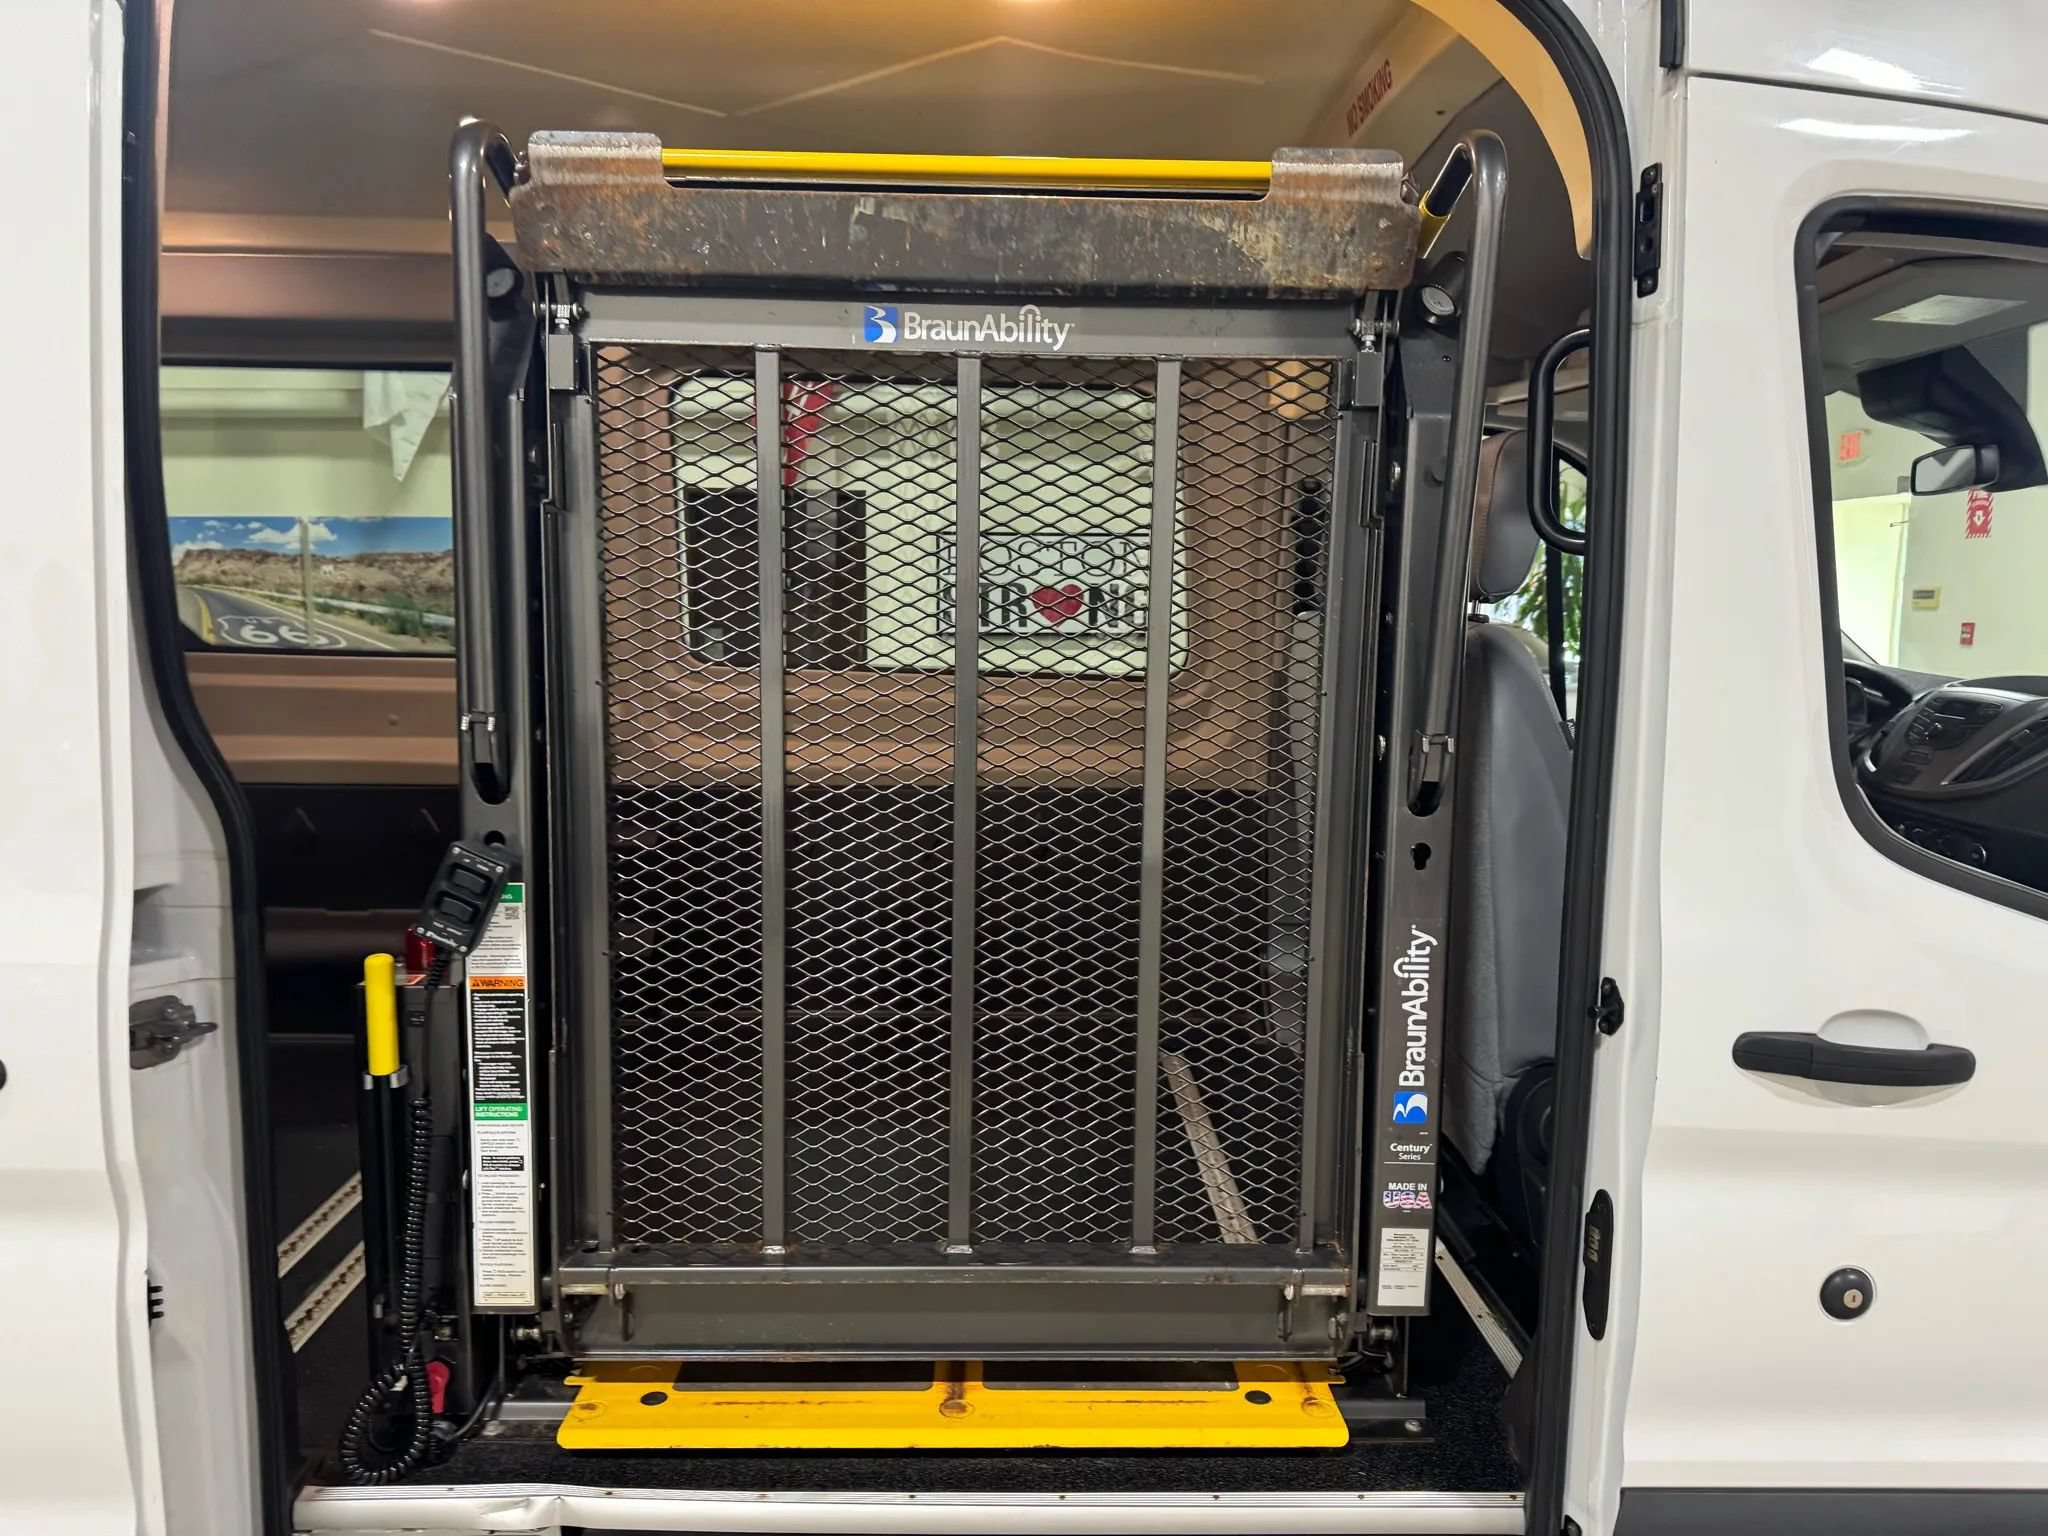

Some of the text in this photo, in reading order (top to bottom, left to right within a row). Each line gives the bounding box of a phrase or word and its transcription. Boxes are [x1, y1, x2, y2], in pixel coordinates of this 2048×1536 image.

[903, 304, 1070, 351] BraunAbility
[480, 978, 525, 987] WARNING
[1393, 928, 1438, 1087] BraunAbility
[1390, 1143, 1431, 1154] Century
[1388, 1182, 1428, 1191] MADE IN
[1383, 1190, 1433, 1209] USA
